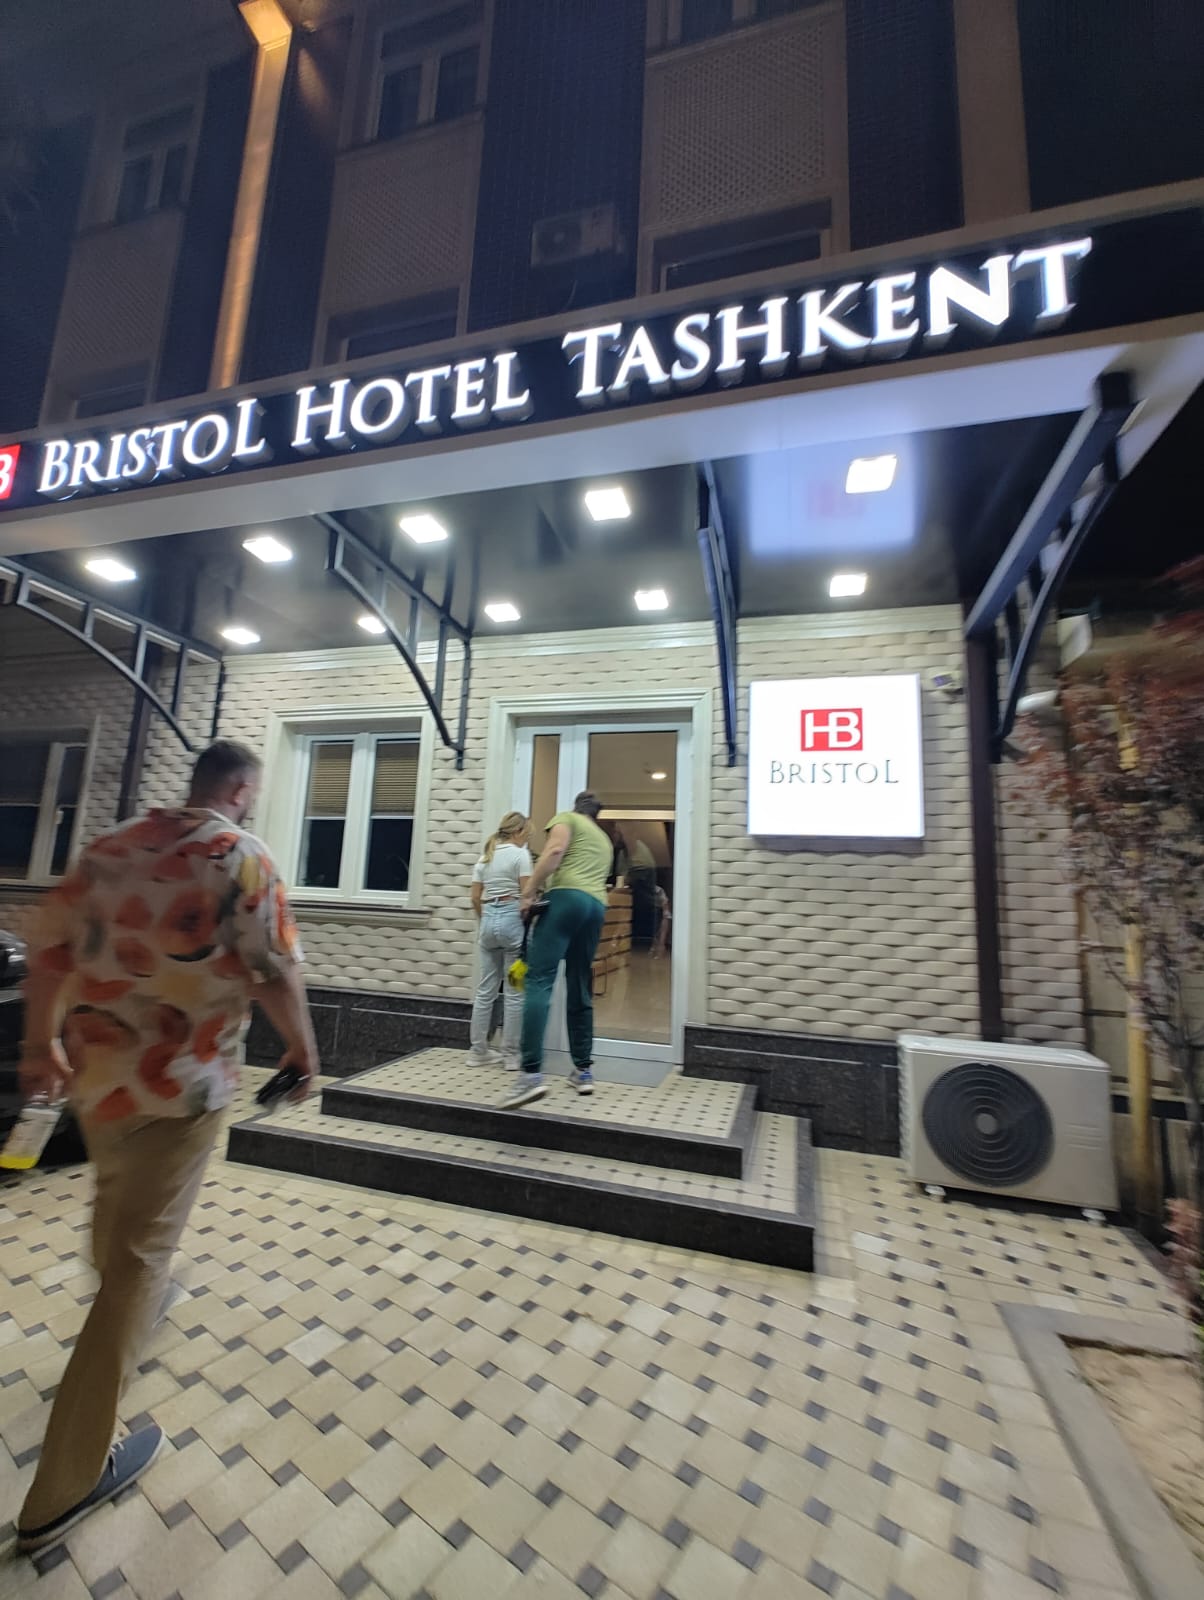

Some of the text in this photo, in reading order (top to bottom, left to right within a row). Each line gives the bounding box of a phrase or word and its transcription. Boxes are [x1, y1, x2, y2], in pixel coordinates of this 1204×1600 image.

[37, 236, 1093, 493] BRISTOL HOTEL TASHKENT
[804, 711, 862, 749] HB
[769, 759, 899, 785] BRISTOL
